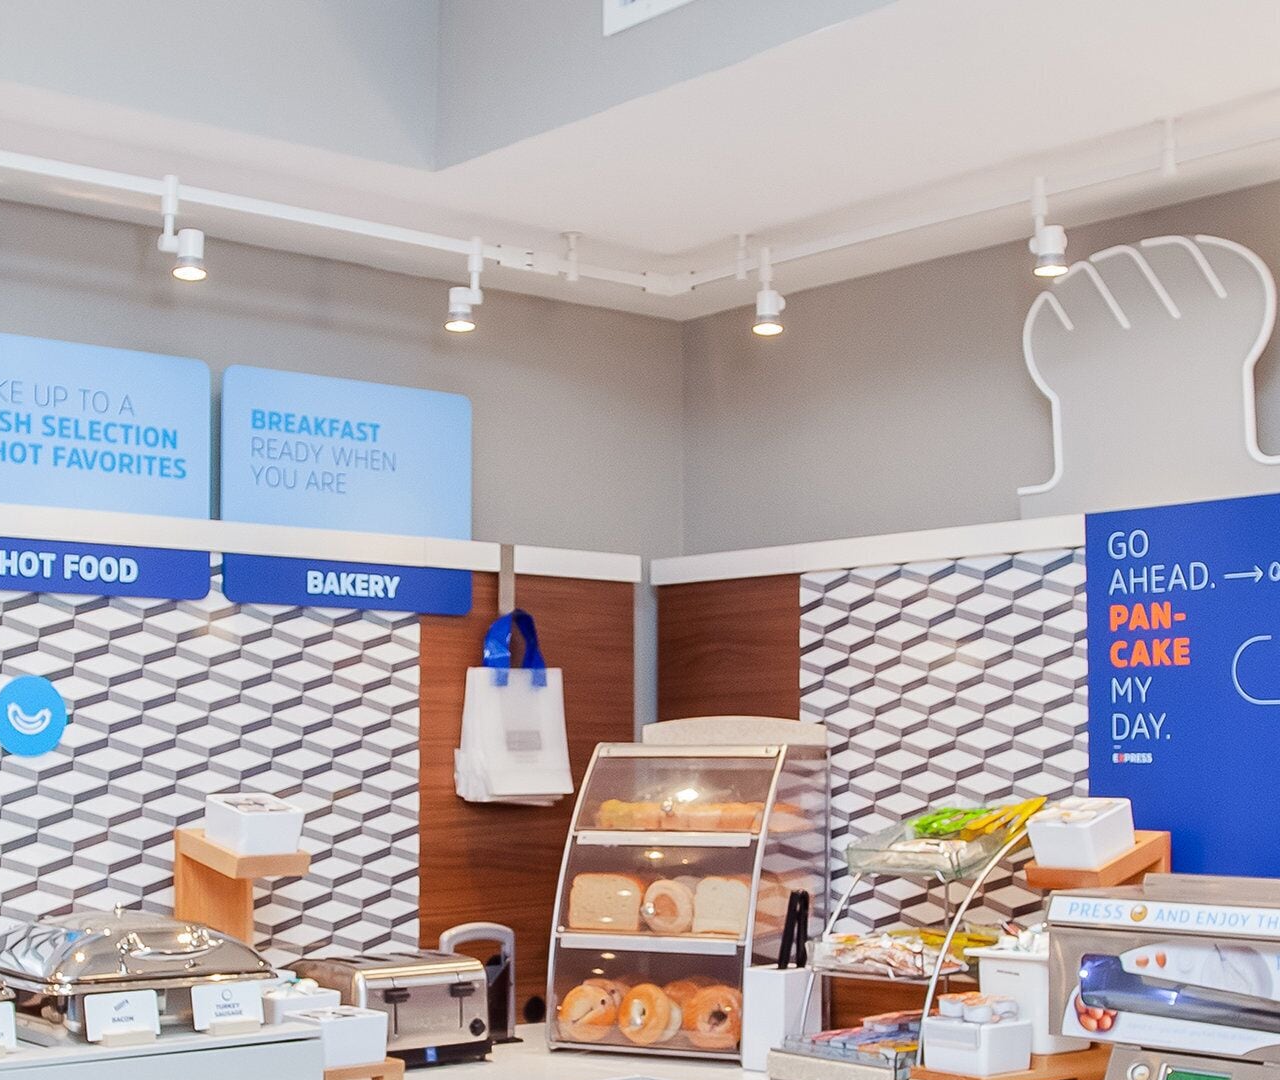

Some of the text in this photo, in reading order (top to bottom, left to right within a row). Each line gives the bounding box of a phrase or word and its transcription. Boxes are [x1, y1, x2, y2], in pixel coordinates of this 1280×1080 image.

[34, 385, 68, 409] UP
[79, 389, 109, 414] TO
[118, 394, 135, 416] A
[42, 415, 178, 449] SELECTION
[251, 408, 381, 443] BREAKFAST
[53, 446, 187, 479] FAVORITES
[251, 438, 397, 473] READY WHEN
[251, 466, 347, 494] YOU ARE
[1107, 529, 1149, 559] GO
[64, 554, 138, 583] FOOD
[1109, 562, 1216, 595] AHEAD.
[307, 571, 400, 599] BAKERY
[1109, 602, 1187, 632] PAN-
[1109, 637, 1191, 667] CAKE
[1111, 676, 1152, 704] MY
[1111, 712, 1171, 741] DAY.
[1112, 752, 1153, 764] EXPRESS
[1069, 902, 1124, 919] PRESS
[1155, 909, 1190, 924] AND
[1196, 911, 1251, 928] ENJOY
[111, 1015, 135, 1023] BACON
[215, 1002, 240, 1010] TURKEY
